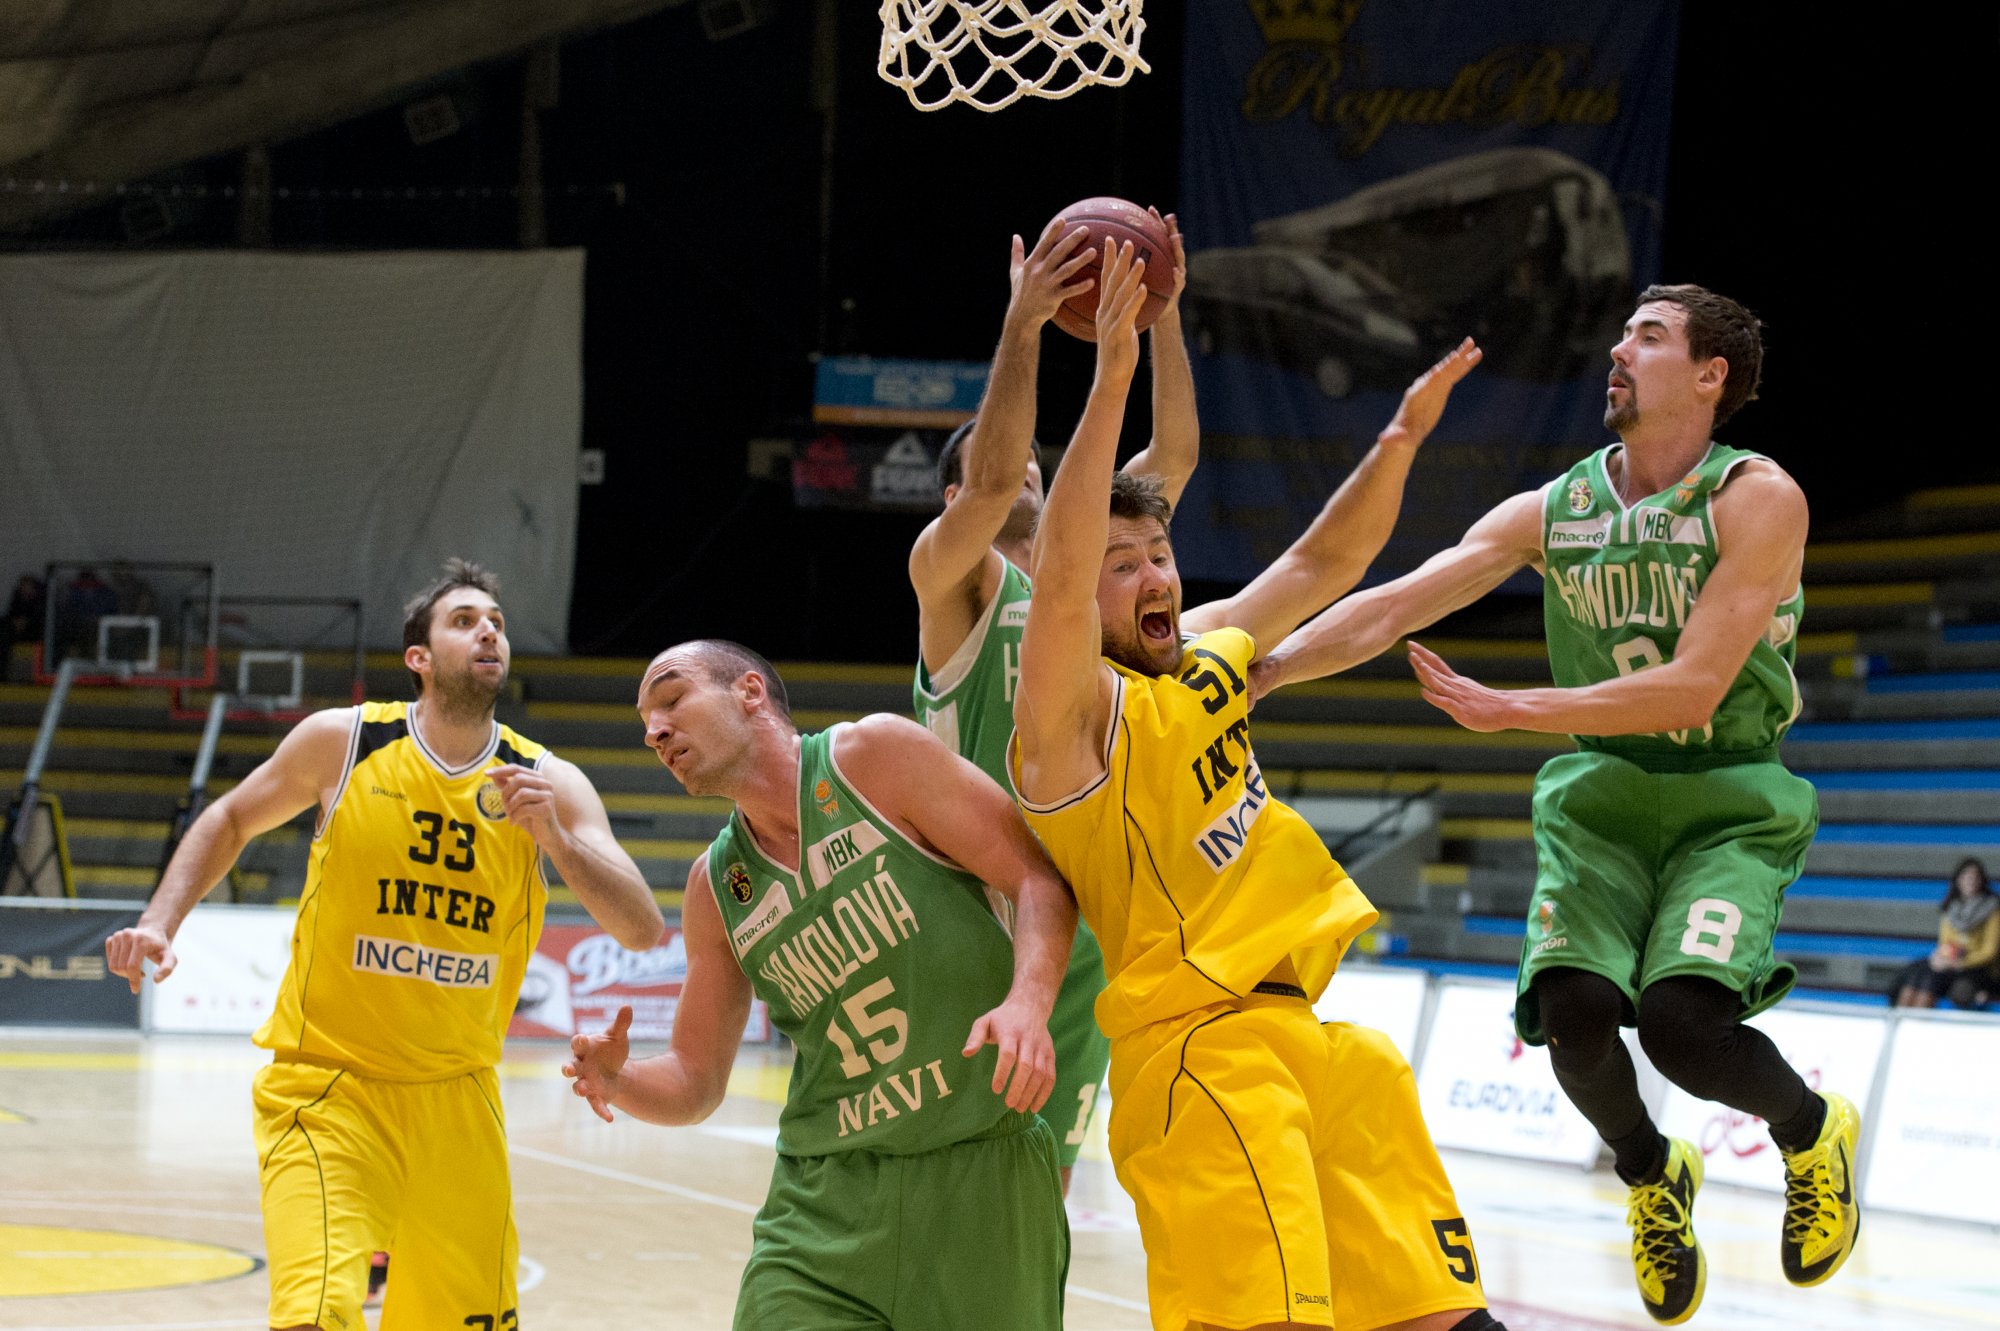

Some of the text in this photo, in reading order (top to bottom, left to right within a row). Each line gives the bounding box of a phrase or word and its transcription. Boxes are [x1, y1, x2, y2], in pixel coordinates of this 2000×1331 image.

[1552, 528, 1606, 544] macro
[1643, 513, 1675, 541] MBK
[1180, 648, 1246, 715] 51
[1192, 717, 1248, 806] INT
[408, 810, 476, 873] 33
[823, 830, 862, 872] MBK
[377, 878, 496, 933] INTER
[1680, 898, 1742, 963] 8
[355, 938, 490, 985] INCHEBA
[827, 976, 909, 1079] 15
[837, 1059, 953, 1138] NAVI
[1295, 1292, 1329, 1307] SPALDING
